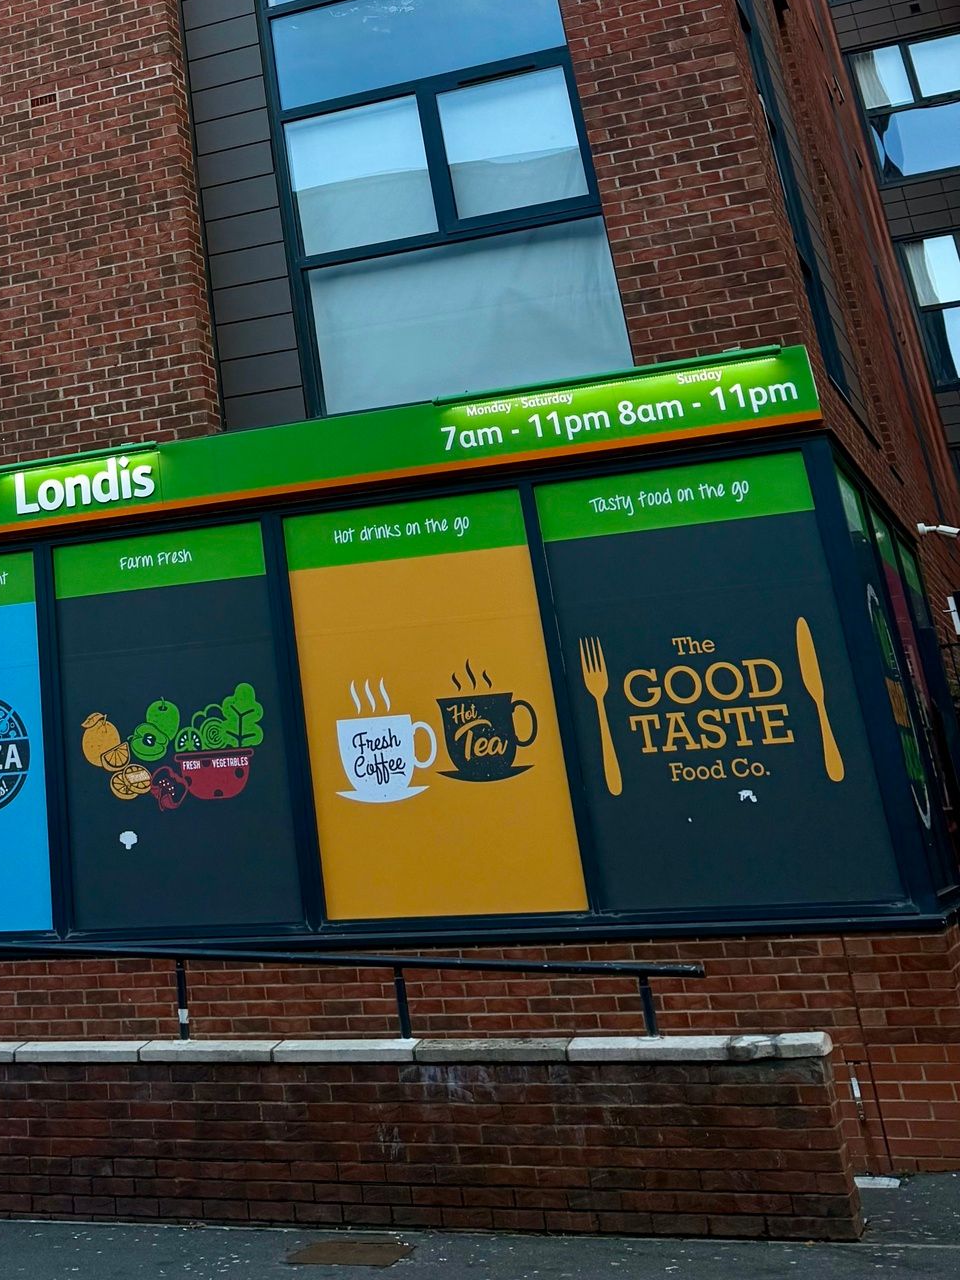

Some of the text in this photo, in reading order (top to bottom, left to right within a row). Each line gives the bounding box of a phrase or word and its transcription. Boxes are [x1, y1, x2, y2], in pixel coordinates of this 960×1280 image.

[676, 370, 723, 385] Sunday
[440, 425, 503, 451] 7am
[528, 409, 611, 440] 11pm
[617, 398, 684, 425] 8am
[709, 380, 799, 413] 11pm
[466, 402, 512, 417] Monday
[520, 393, 573, 409] Saturday
[14, 455, 155, 515] Londis
[589, 480, 749, 516] Tasty food on the go
[334, 516, 470, 544] Hot drinks on the go
[120, 549, 192, 570] Farm Fresh
[672, 636, 716, 656] The
[623, 658, 783, 708] GOOD
[447, 703, 476, 724] Hot
[352, 728, 401, 755] Fresh
[454, 718, 508, 761] Tea
[629, 703, 795, 754] TASTE
[182, 756, 249, 770] FRESH VEGETABLES
[354, 753, 406, 785] Coffee
[669, 758, 771, 782] Food Co.
